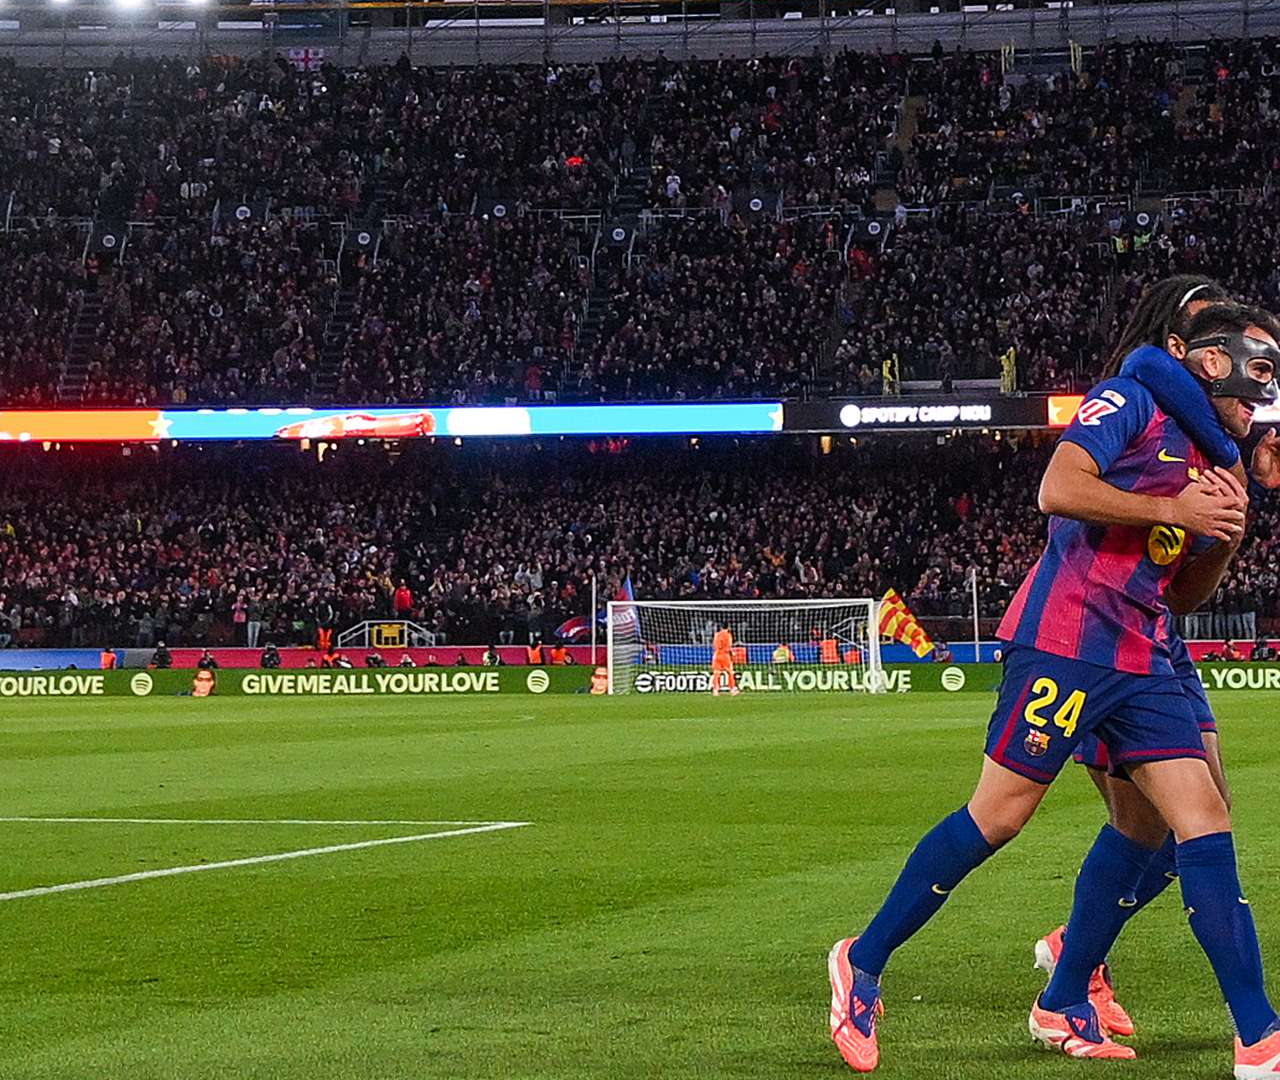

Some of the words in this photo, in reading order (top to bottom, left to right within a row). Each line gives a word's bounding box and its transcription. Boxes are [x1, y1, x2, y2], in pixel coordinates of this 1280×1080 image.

[49, 676, 104, 695] LOVE
[242, 674, 295, 694] GIVE
[297, 674, 332, 693] ME
[332, 674, 374, 693] ALL
[375, 673, 439, 693] YOUR
[441, 672, 499, 692] LOVE
[742, 670, 782, 690] ALL
[783, 670, 848, 690] YOUR
[848, 669, 912, 690] LOVE
[1024, 677, 1086, 738] 24
